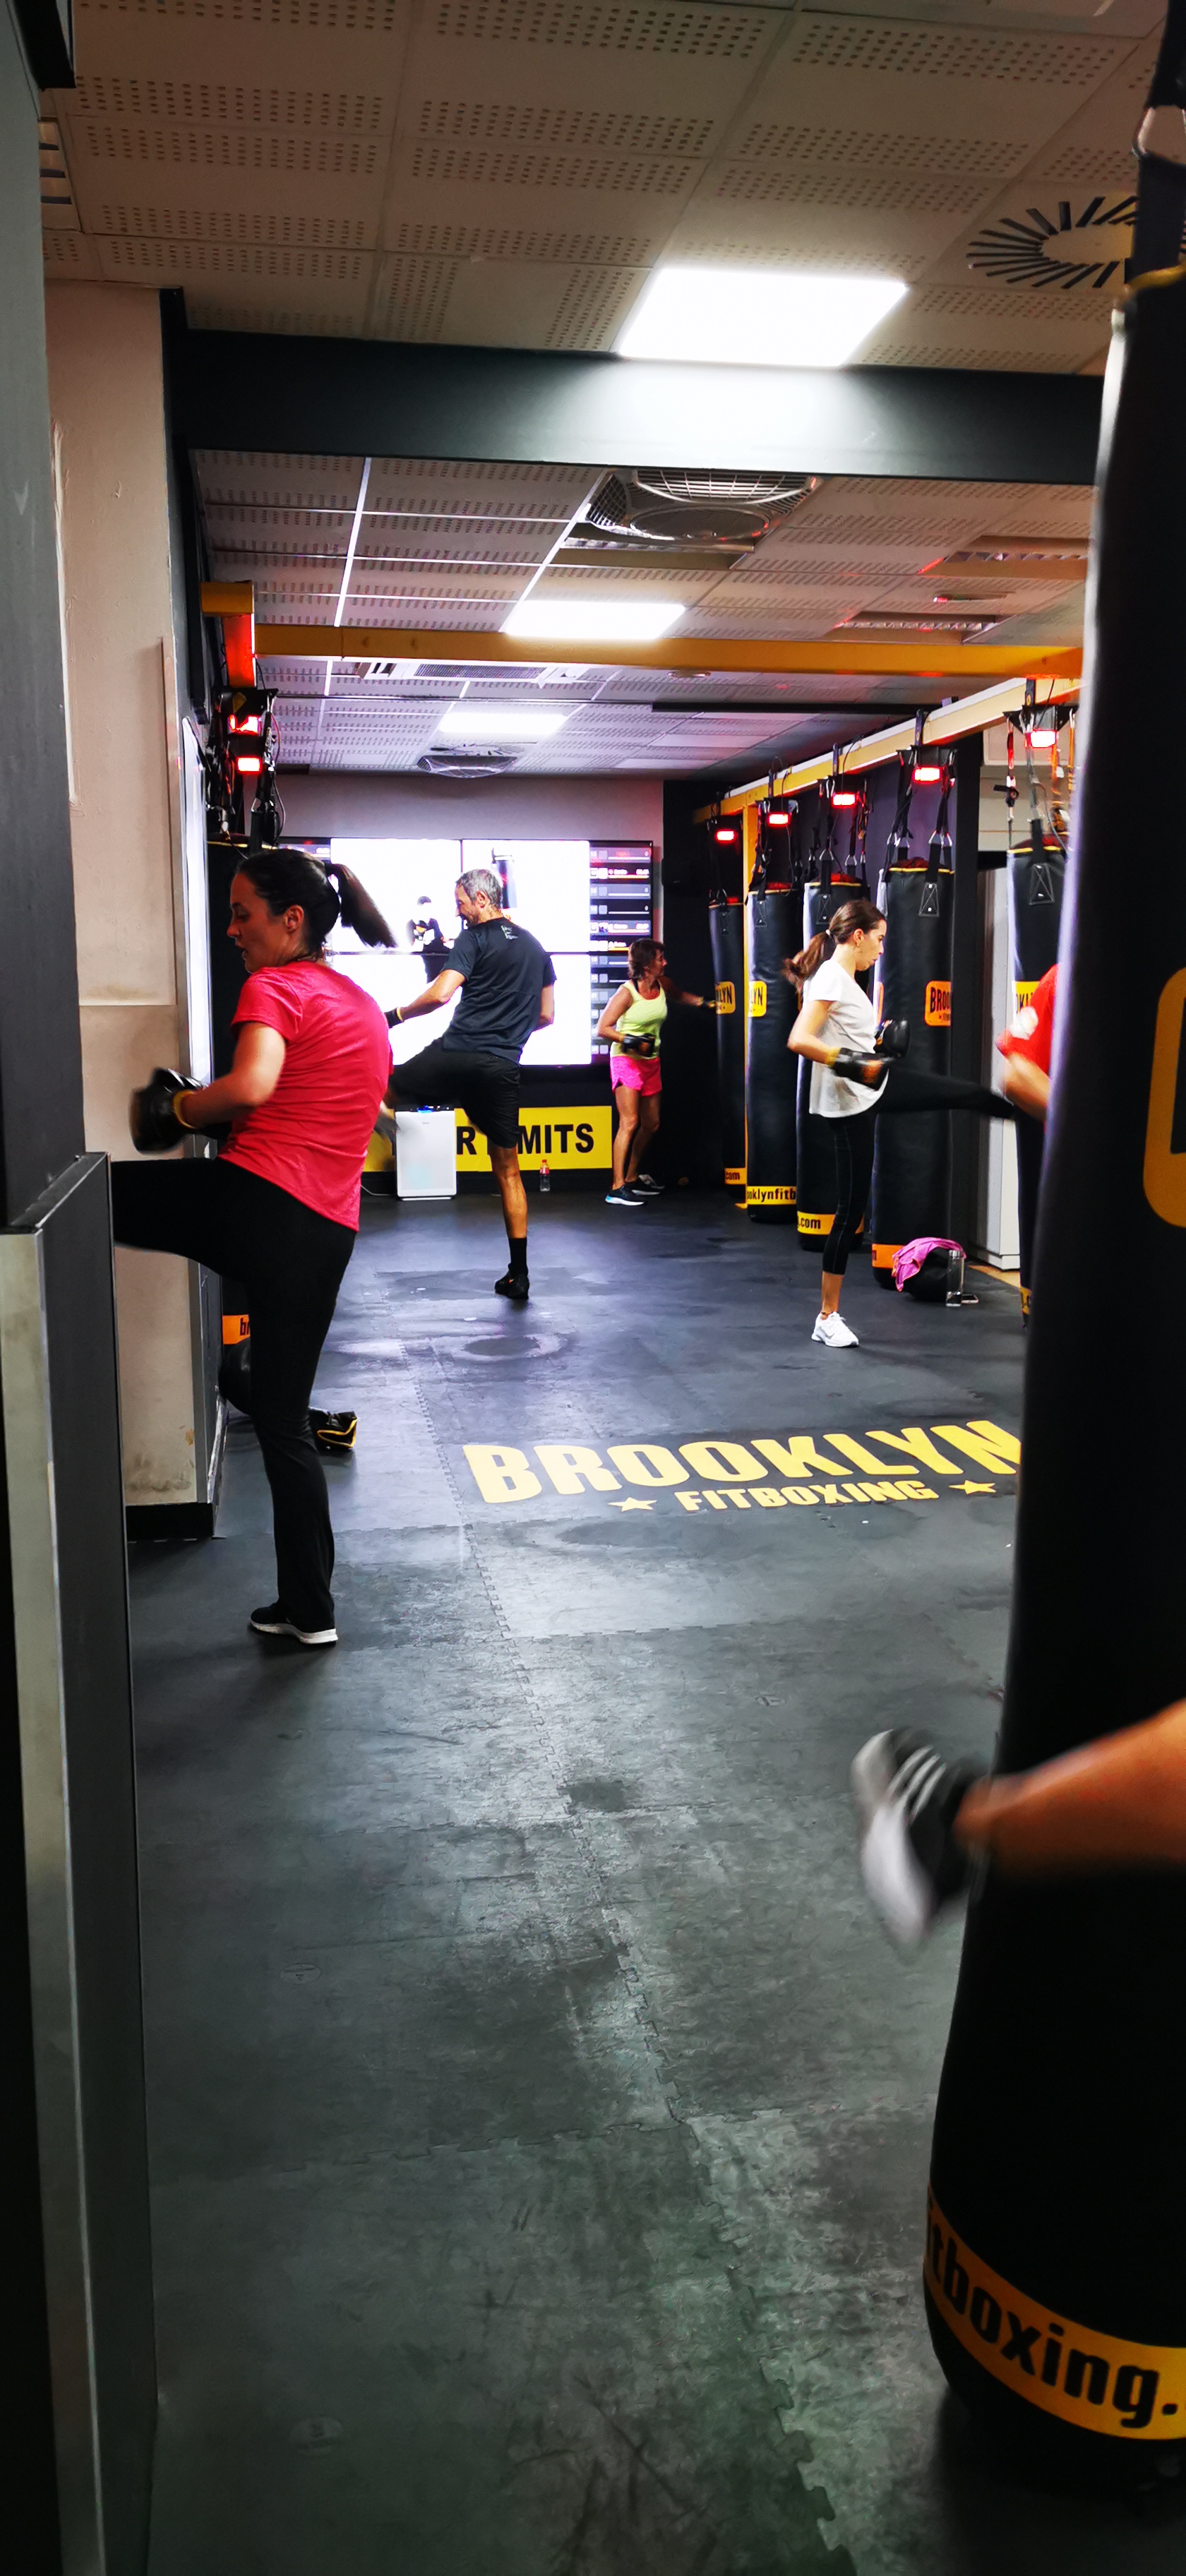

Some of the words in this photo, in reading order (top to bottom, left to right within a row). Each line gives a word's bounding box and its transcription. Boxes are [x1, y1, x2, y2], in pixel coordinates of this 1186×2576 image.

[487, 1123, 594, 1155] MITS
[462, 1420, 1022, 1503] BROOKLYN
[674, 1480, 940, 1511] FITBOXING
